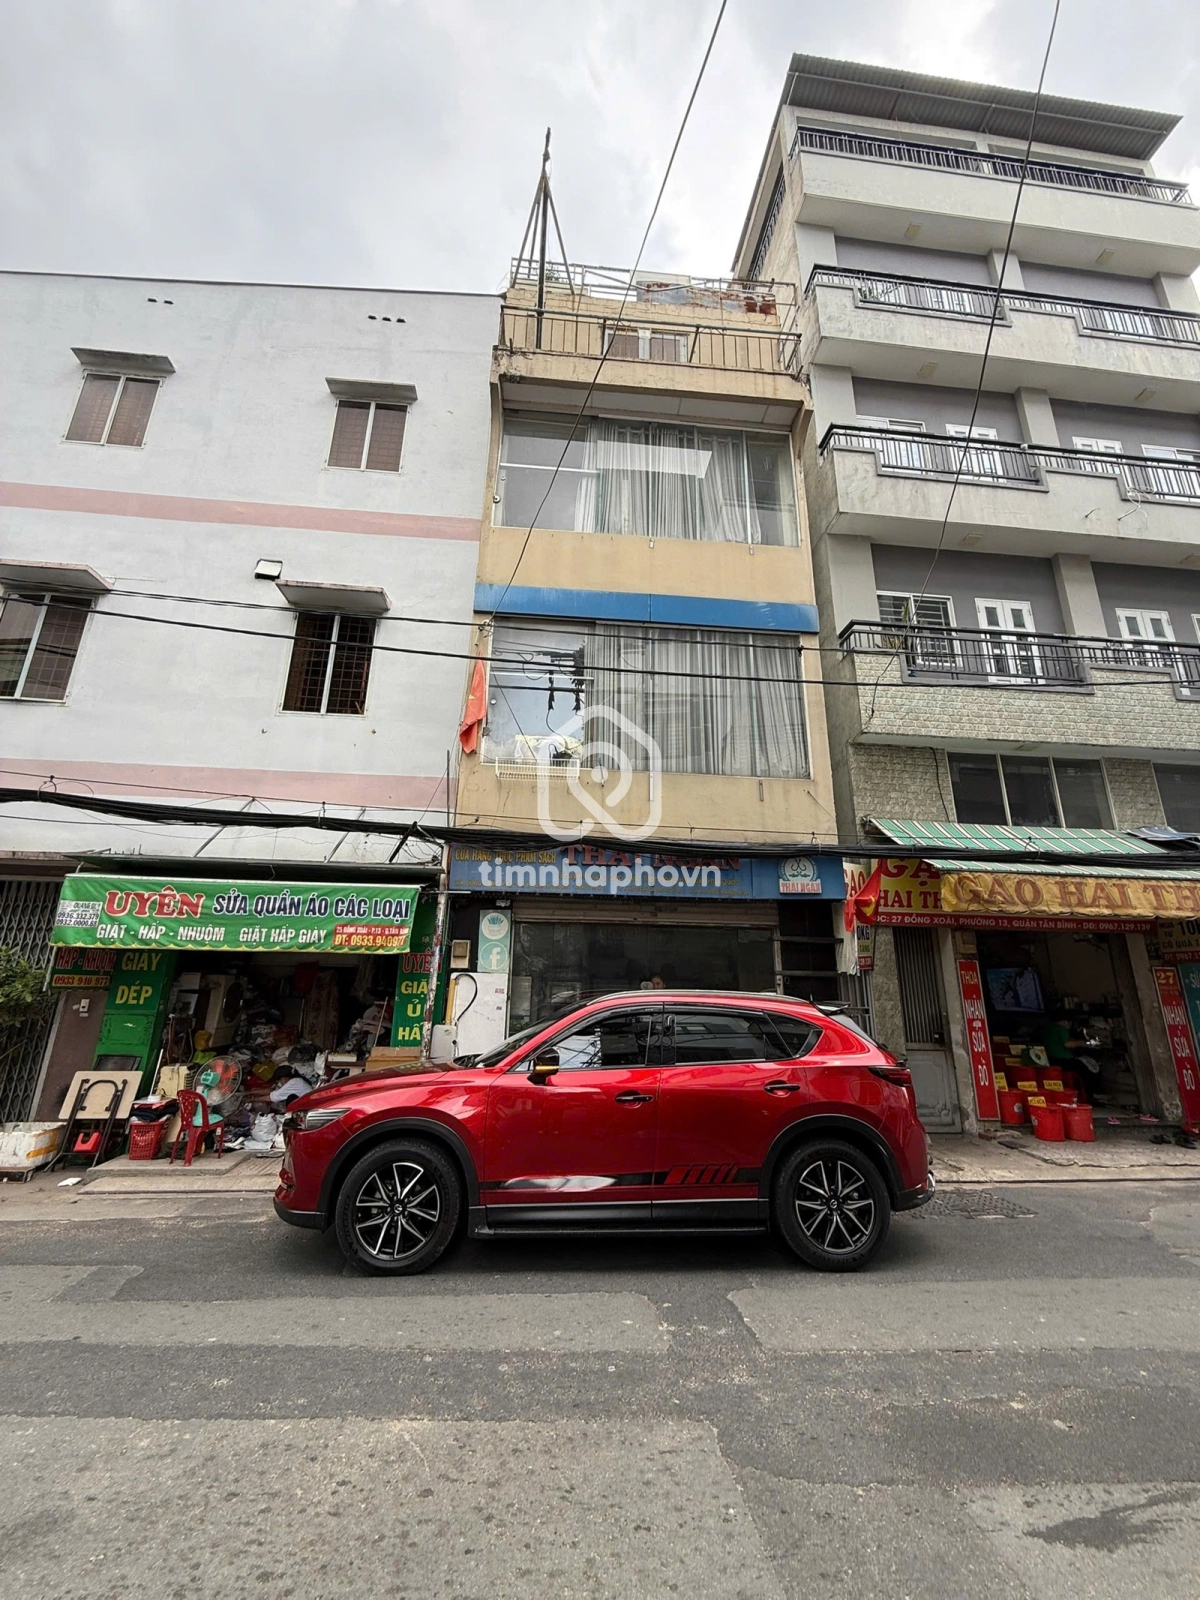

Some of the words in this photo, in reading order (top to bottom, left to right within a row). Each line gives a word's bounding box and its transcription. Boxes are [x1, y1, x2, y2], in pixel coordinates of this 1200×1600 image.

[104, 885, 206, 918] UYÊN
[212, 888, 248, 915] SỬA
[304, 892, 330, 918] ÁO
[333, 893, 369, 918] CÁC
[371, 898, 411, 923] LOẠI
[1055, 881, 1137, 910] HAI
[892, 915, 901, 923] 27
[96, 921, 127, 942] GIẶT
[138, 921, 166, 940] HẤP
[177, 924, 226, 944] NHUỘM
[239, 925, 268, 945] GIẶT
[270, 923, 296, 943] HẤP
[298, 926, 328, 944] GIÀY
[350, 935, 407, 947] 0933.940977
[54, 975, 75, 985] 0933
[1156, 971, 1174, 985] 27
[115, 980, 153, 1005] DÉP
